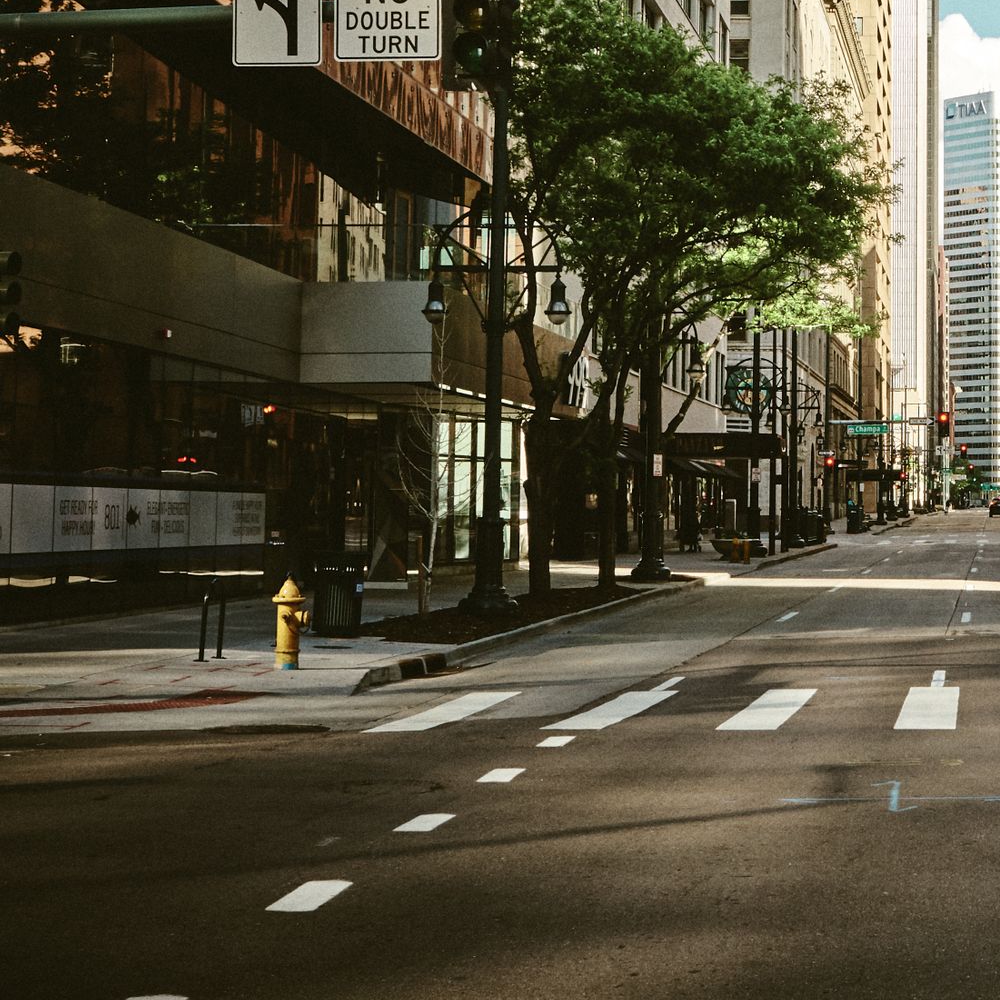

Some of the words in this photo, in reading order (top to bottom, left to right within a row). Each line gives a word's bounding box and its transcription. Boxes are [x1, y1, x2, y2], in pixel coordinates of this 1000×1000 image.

[346, 11, 430, 30] DOUBLE
[358, 35, 419, 53] TURN
[958, 100, 987, 118] TIAA
[855, 426, 881, 434] Champa
[71, 500, 87, 515] READY
[104, 504, 120, 530] 801
[62, 520, 78, 536] HAPPY
